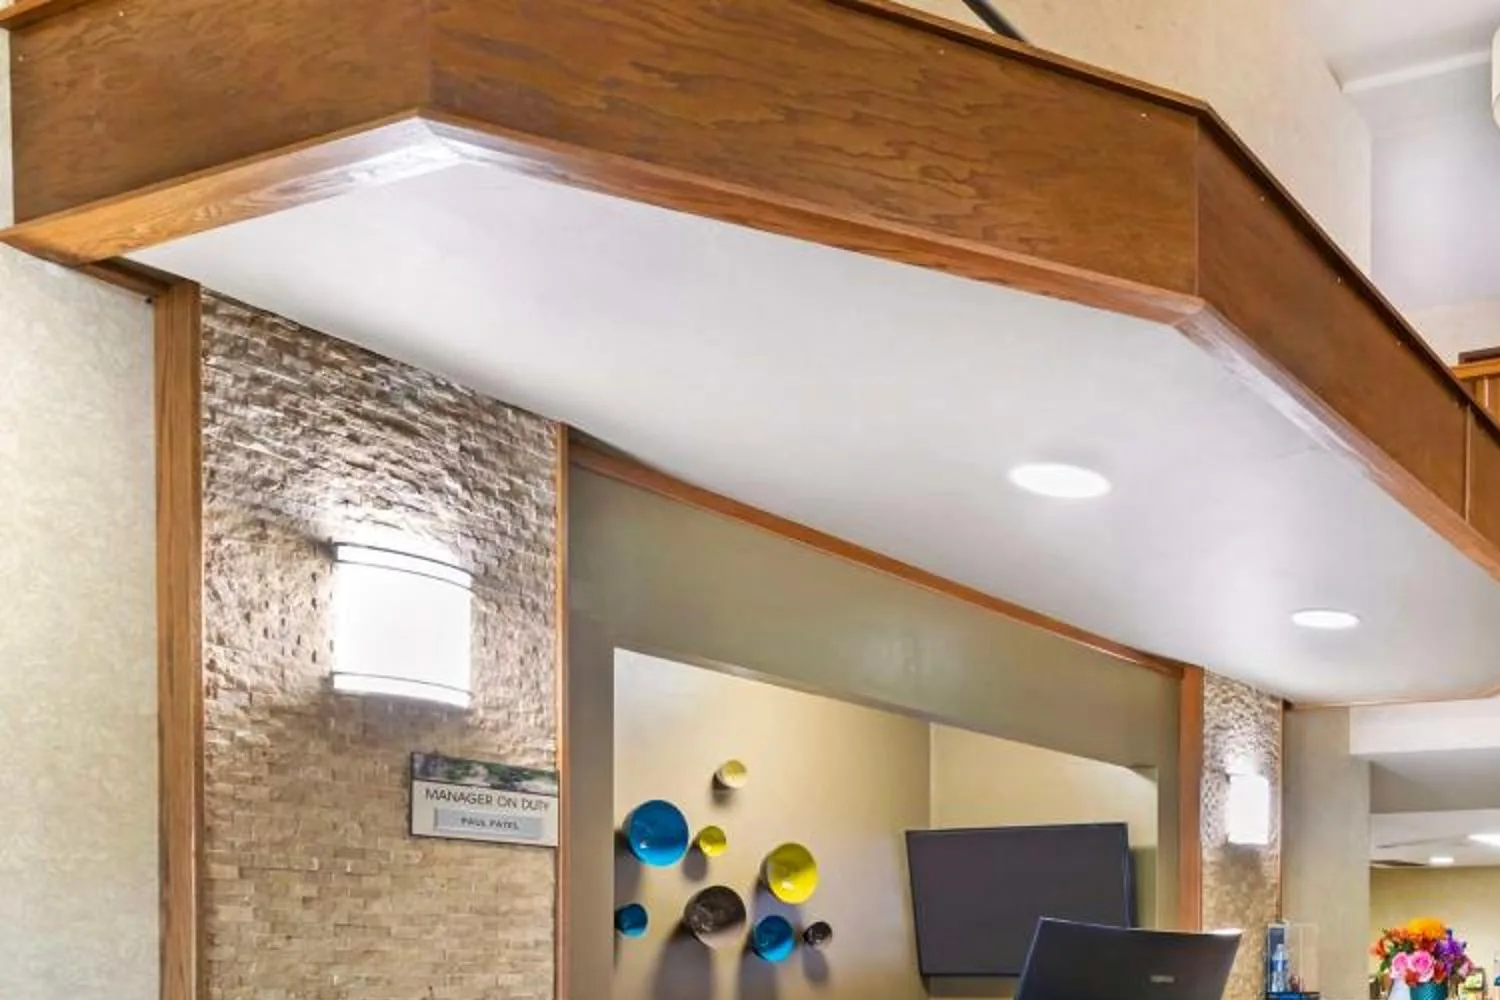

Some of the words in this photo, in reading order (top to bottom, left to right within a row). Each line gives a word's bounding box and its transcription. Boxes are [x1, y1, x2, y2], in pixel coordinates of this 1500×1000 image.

[425, 788, 493, 805] MANAGER
[497, 796, 517, 809] ON
[521, 798, 549, 812] DUTY
[461, 816, 486, 828] PAUL
